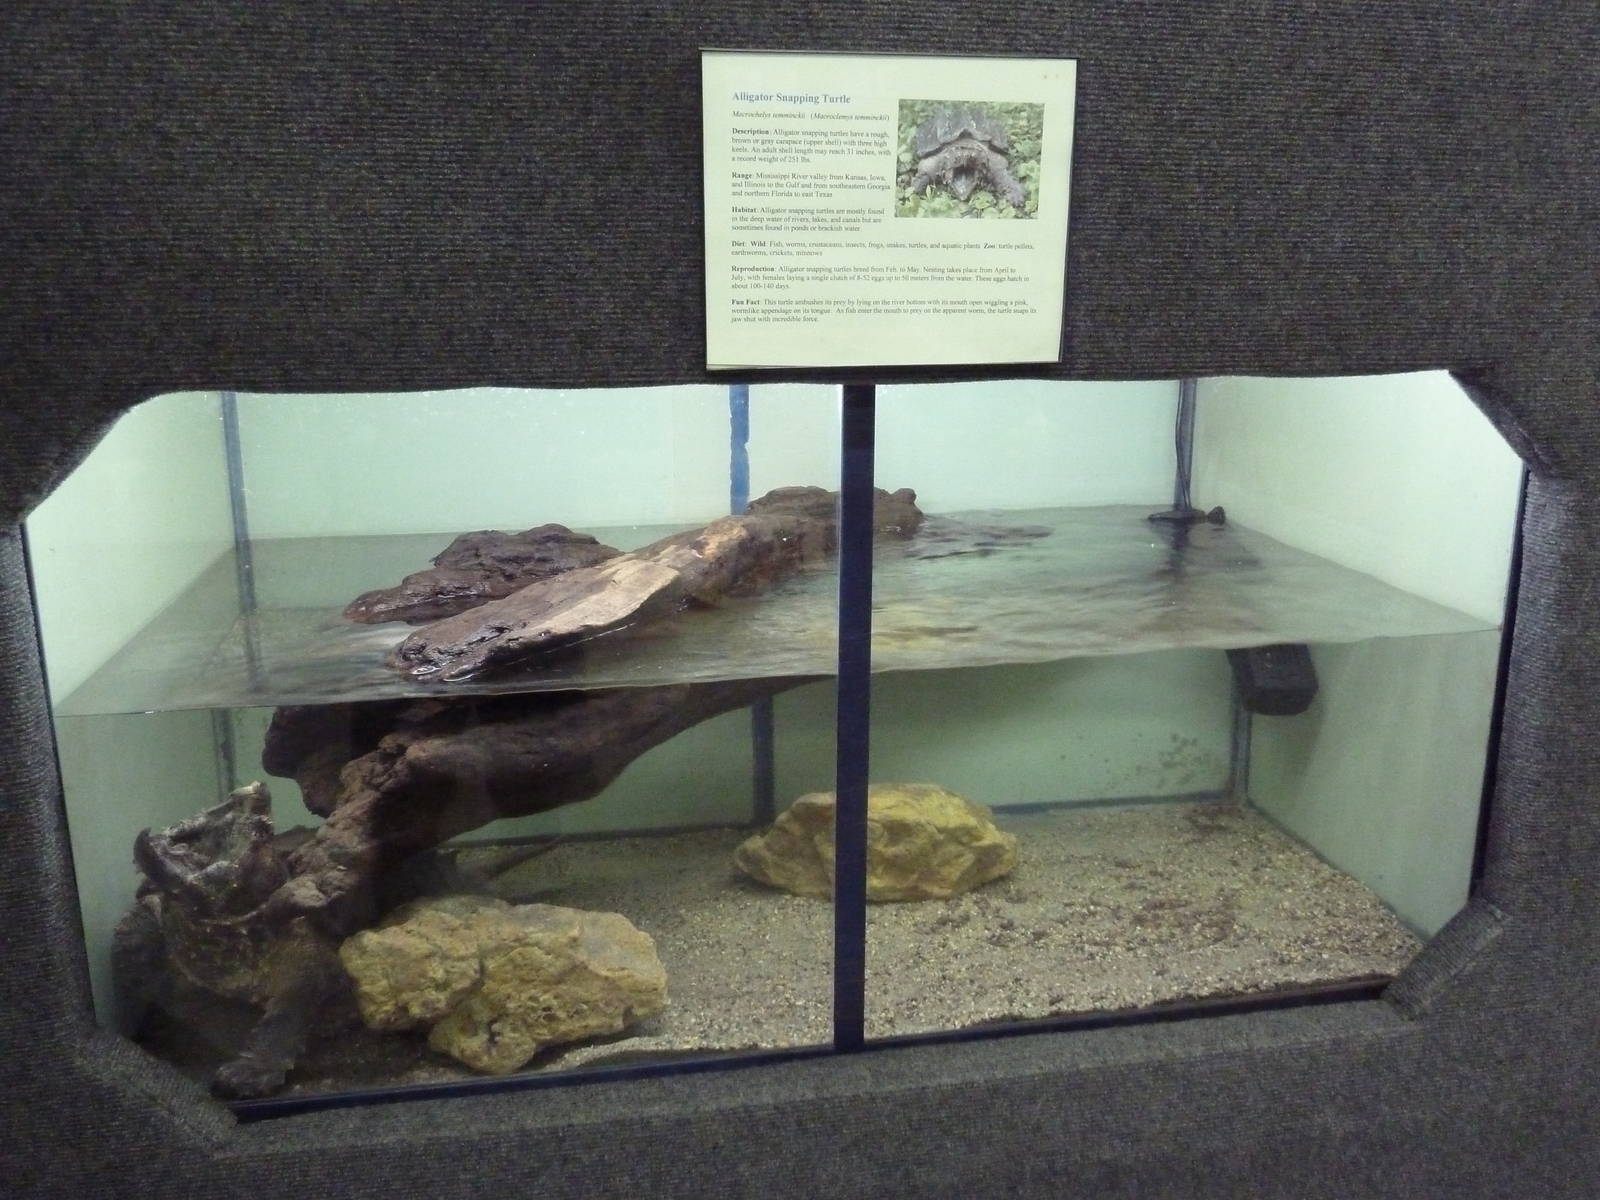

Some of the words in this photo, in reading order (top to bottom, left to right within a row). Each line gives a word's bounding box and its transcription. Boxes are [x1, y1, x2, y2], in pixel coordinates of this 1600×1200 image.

[733, 93, 773, 102] Alligator
[776, 93, 819, 104] Snapping
[824, 94, 850, 103] Turtle
